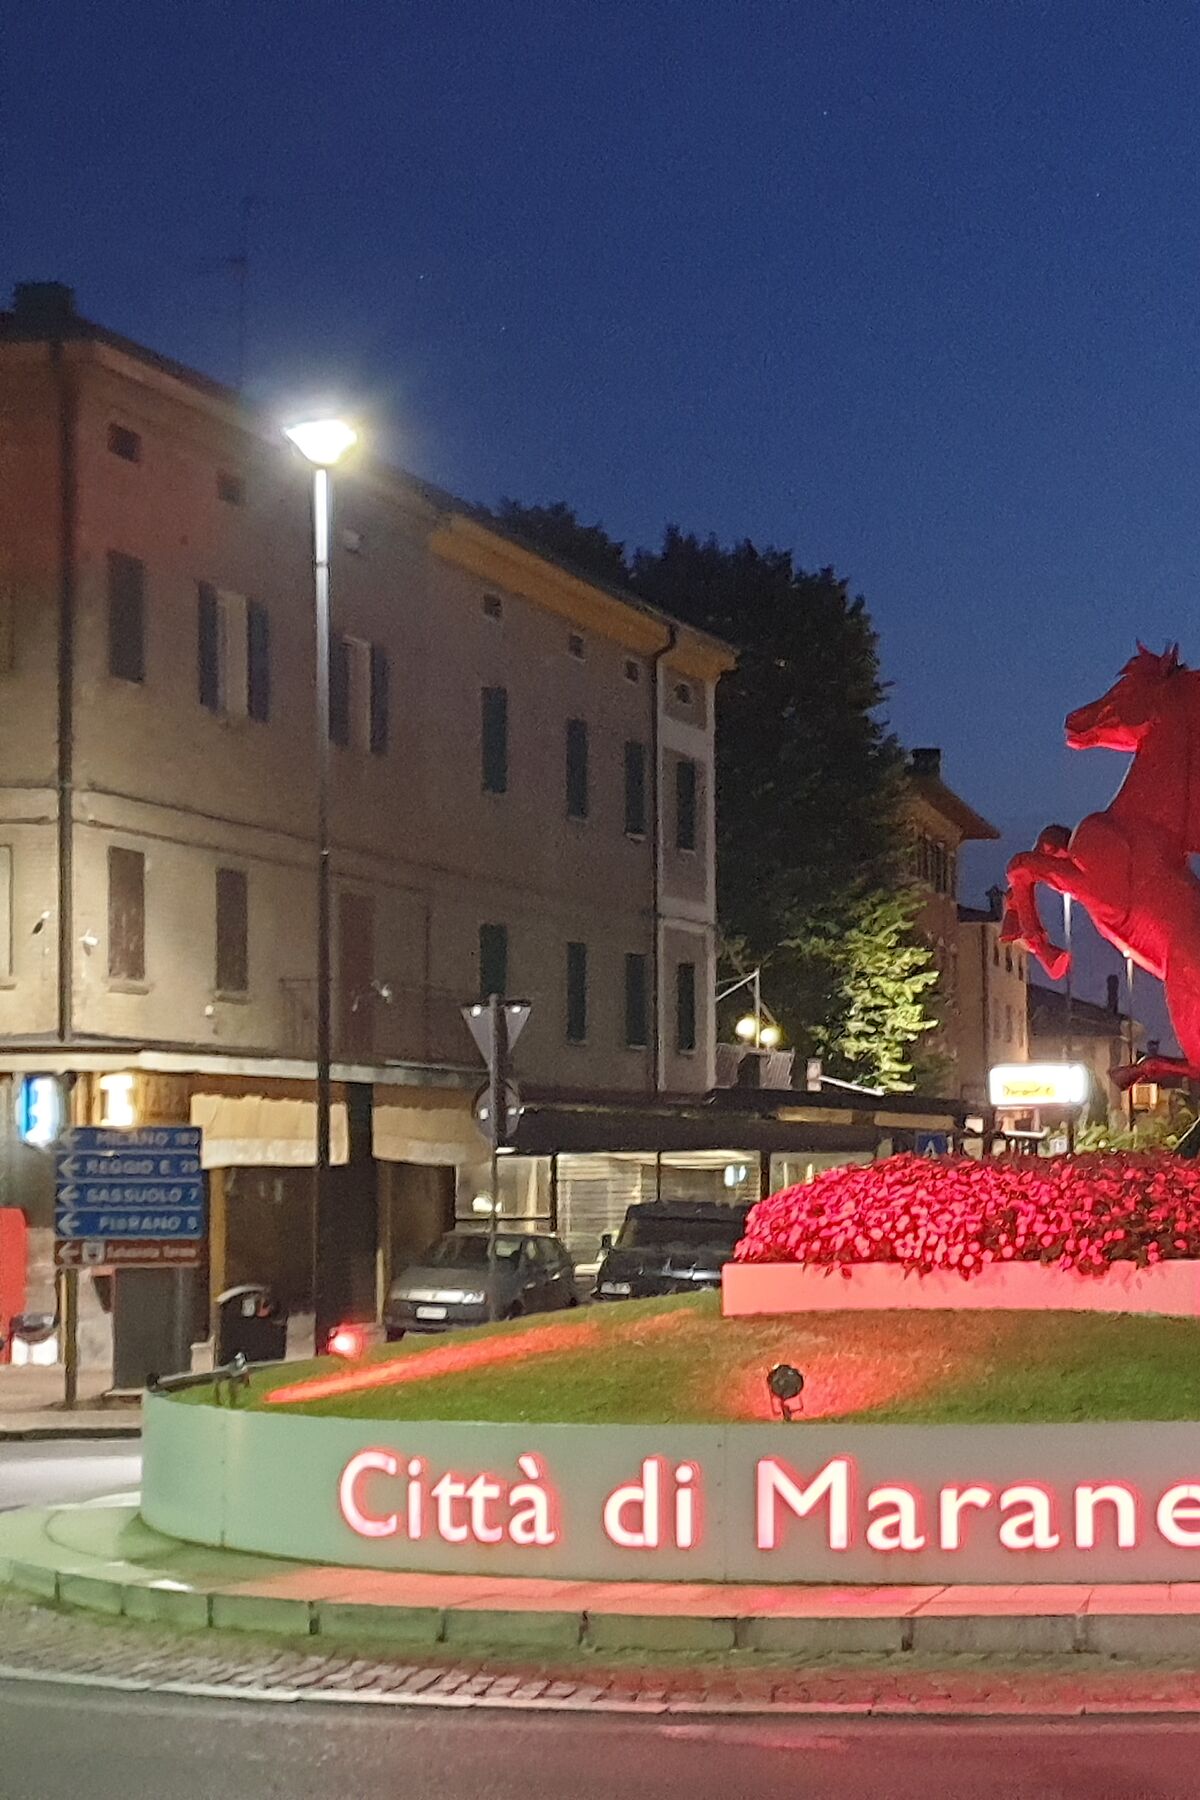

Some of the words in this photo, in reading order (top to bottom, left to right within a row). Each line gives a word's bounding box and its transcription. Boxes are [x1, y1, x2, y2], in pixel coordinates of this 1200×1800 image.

[86, 1159, 154, 1174] REGGIO
[86, 1187, 182, 1203] SASSUOLO
[99, 1216, 181, 1231] FIORANO
[339, 1450, 557, 1545] Città
[603, 1456, 694, 1548] di
